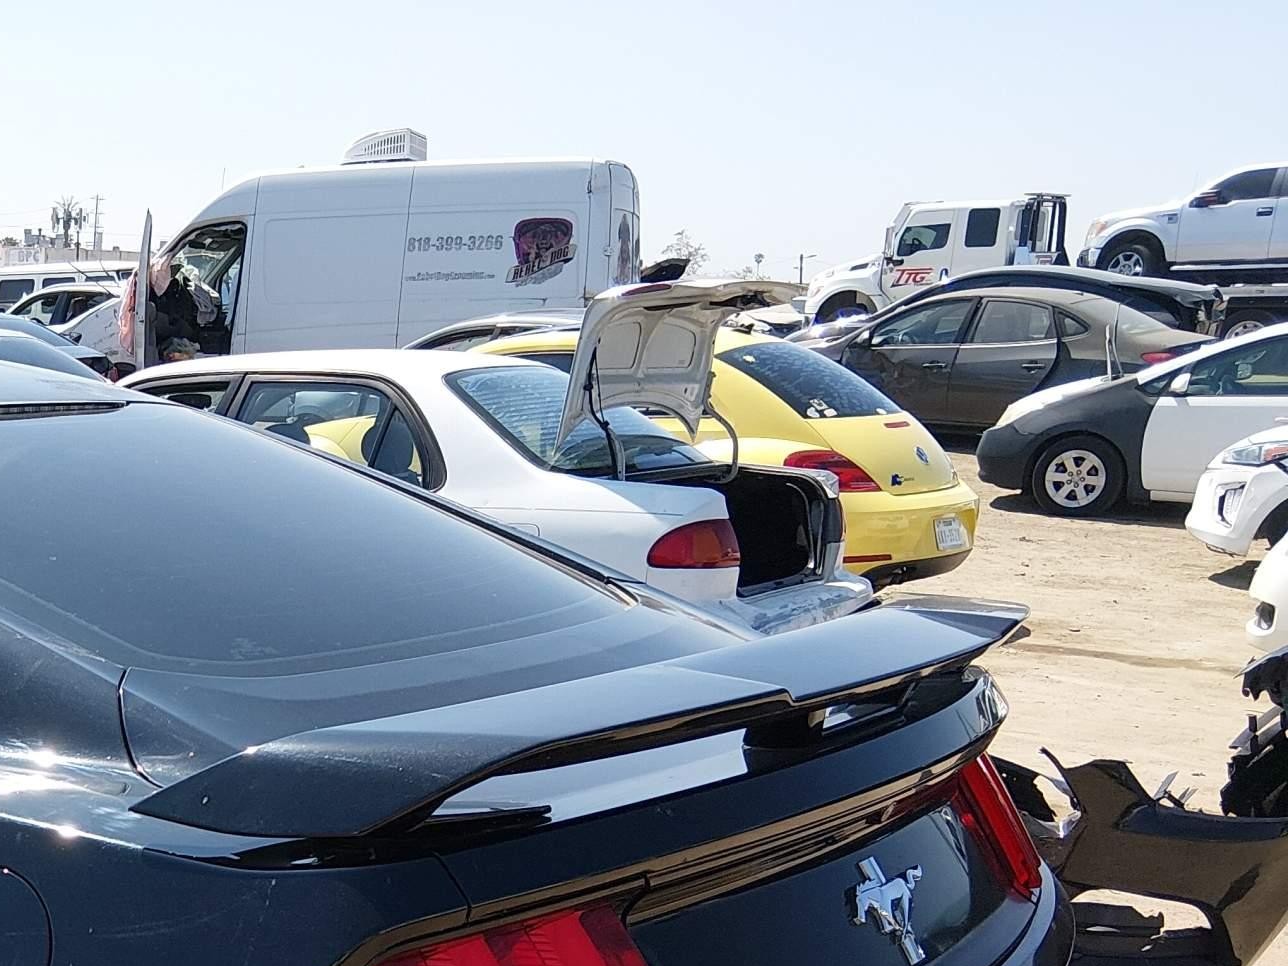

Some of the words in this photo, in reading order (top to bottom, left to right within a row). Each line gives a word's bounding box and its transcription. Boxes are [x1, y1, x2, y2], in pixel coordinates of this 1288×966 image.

[407, 235, 504, 252] 818-399-3266
[550, 245, 570, 264] DOG
[893, 267, 933, 284] TTG
